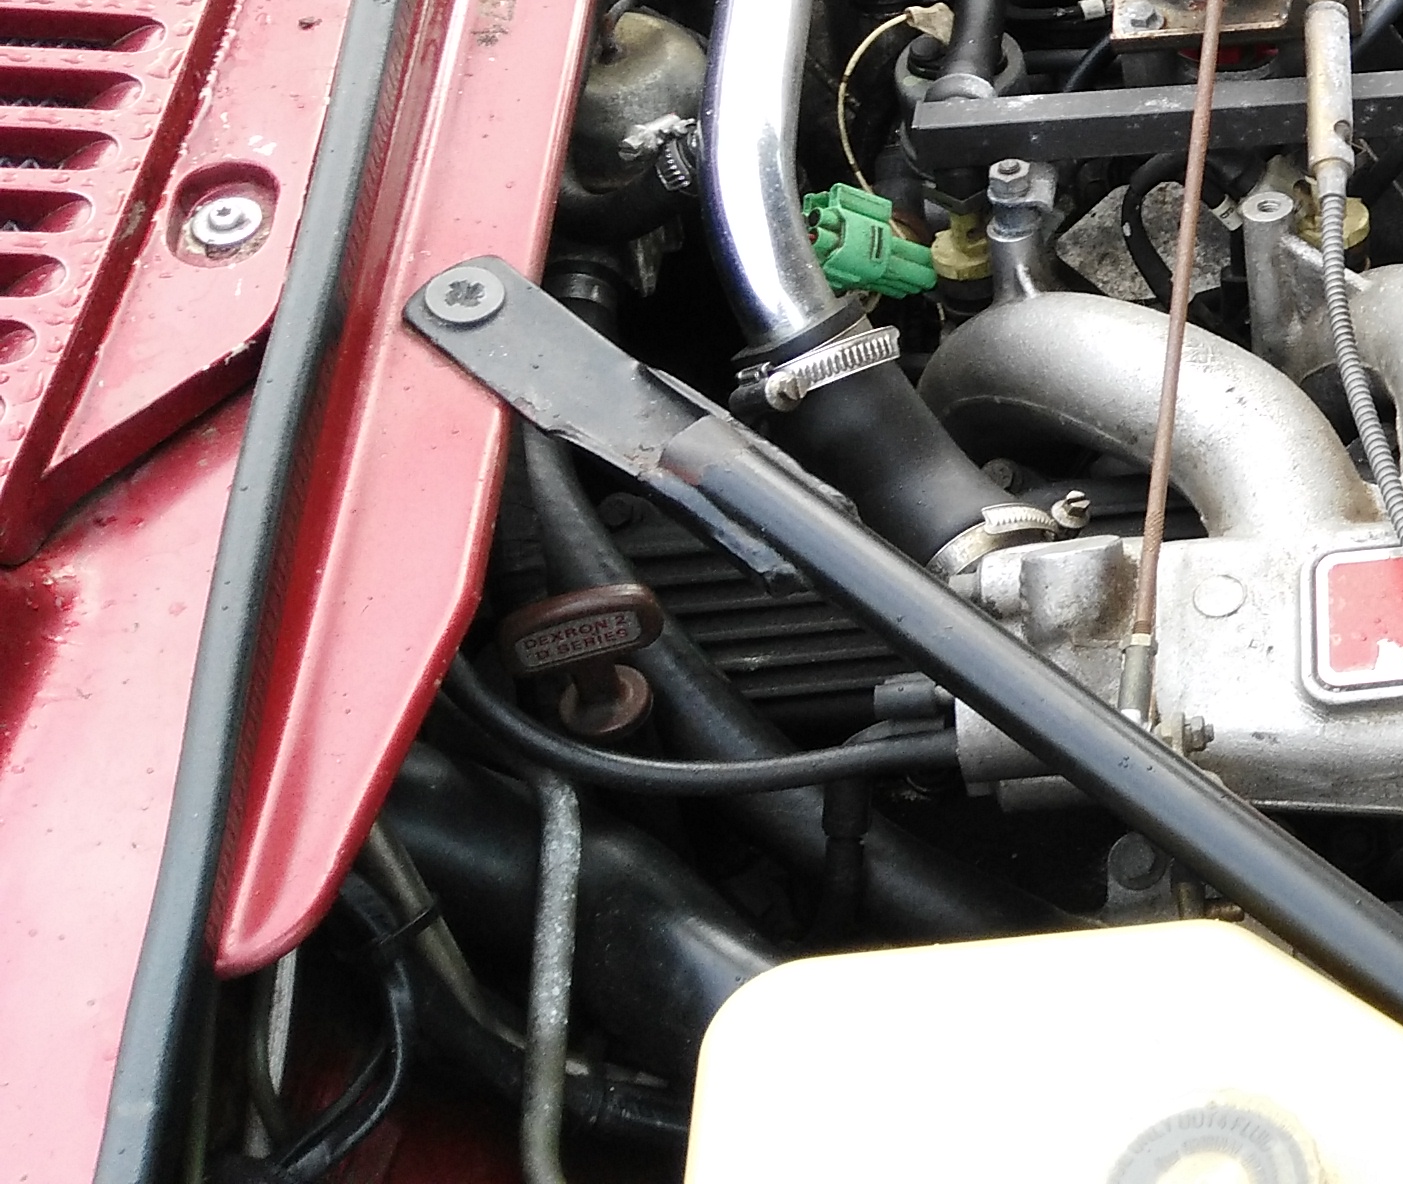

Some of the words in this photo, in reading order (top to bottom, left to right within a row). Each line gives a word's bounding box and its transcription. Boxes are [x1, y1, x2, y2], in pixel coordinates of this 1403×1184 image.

[523, 620, 609, 651] DEXRON
[614, 614, 628, 626] 2
[556, 628, 630, 656] SERIES
